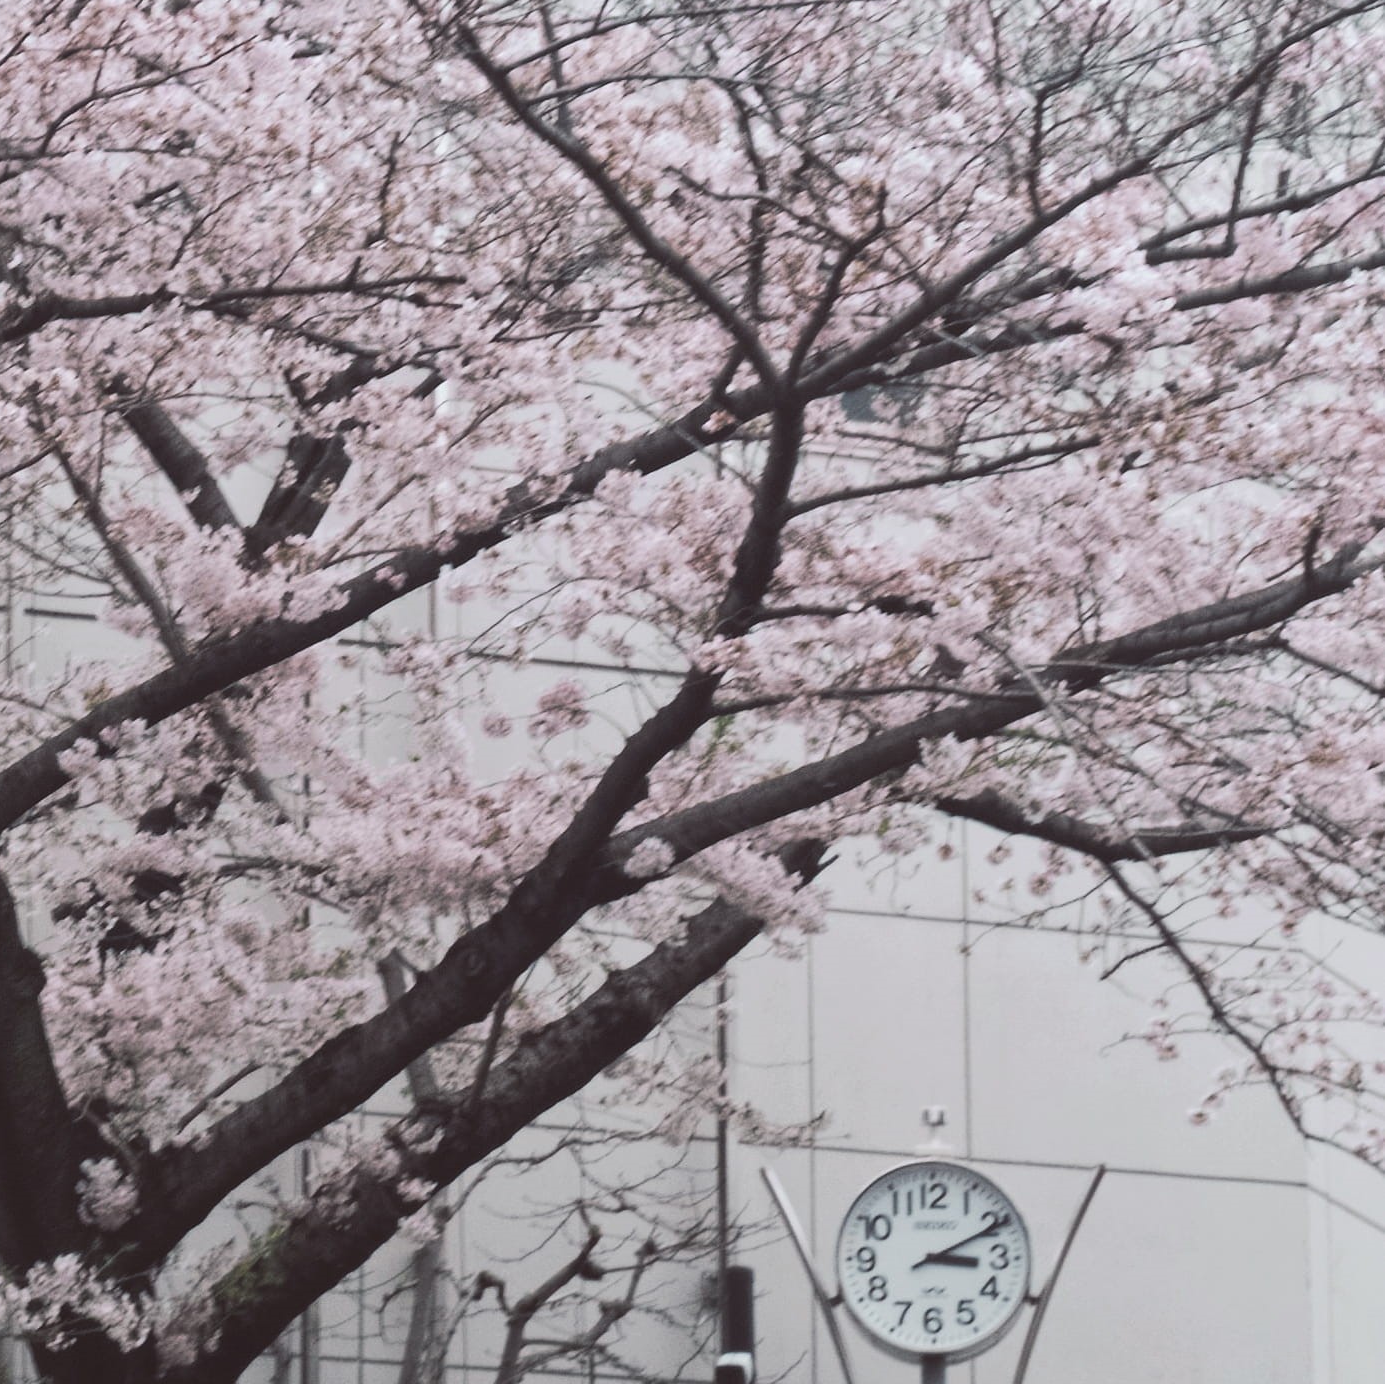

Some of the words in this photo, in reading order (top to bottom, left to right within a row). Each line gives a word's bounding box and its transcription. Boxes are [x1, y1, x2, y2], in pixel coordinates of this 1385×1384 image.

[892, 1190, 913, 1216] 11
[920, 1183, 948, 1210] 12
[963, 1190, 970, 1216] 1
[856, 1214, 892, 1241] 10
[979, 1211, 1001, 1237] 2
[856, 1246, 877, 1273] 9
[989, 1244, 1009, 1270] 3
[867, 1275, 888, 1302] 8
[979, 1276, 1000, 1301] 4
[894, 1301, 913, 1326] 7
[922, 1307, 944, 1334] 6
[956, 1300, 977, 1326] 5
